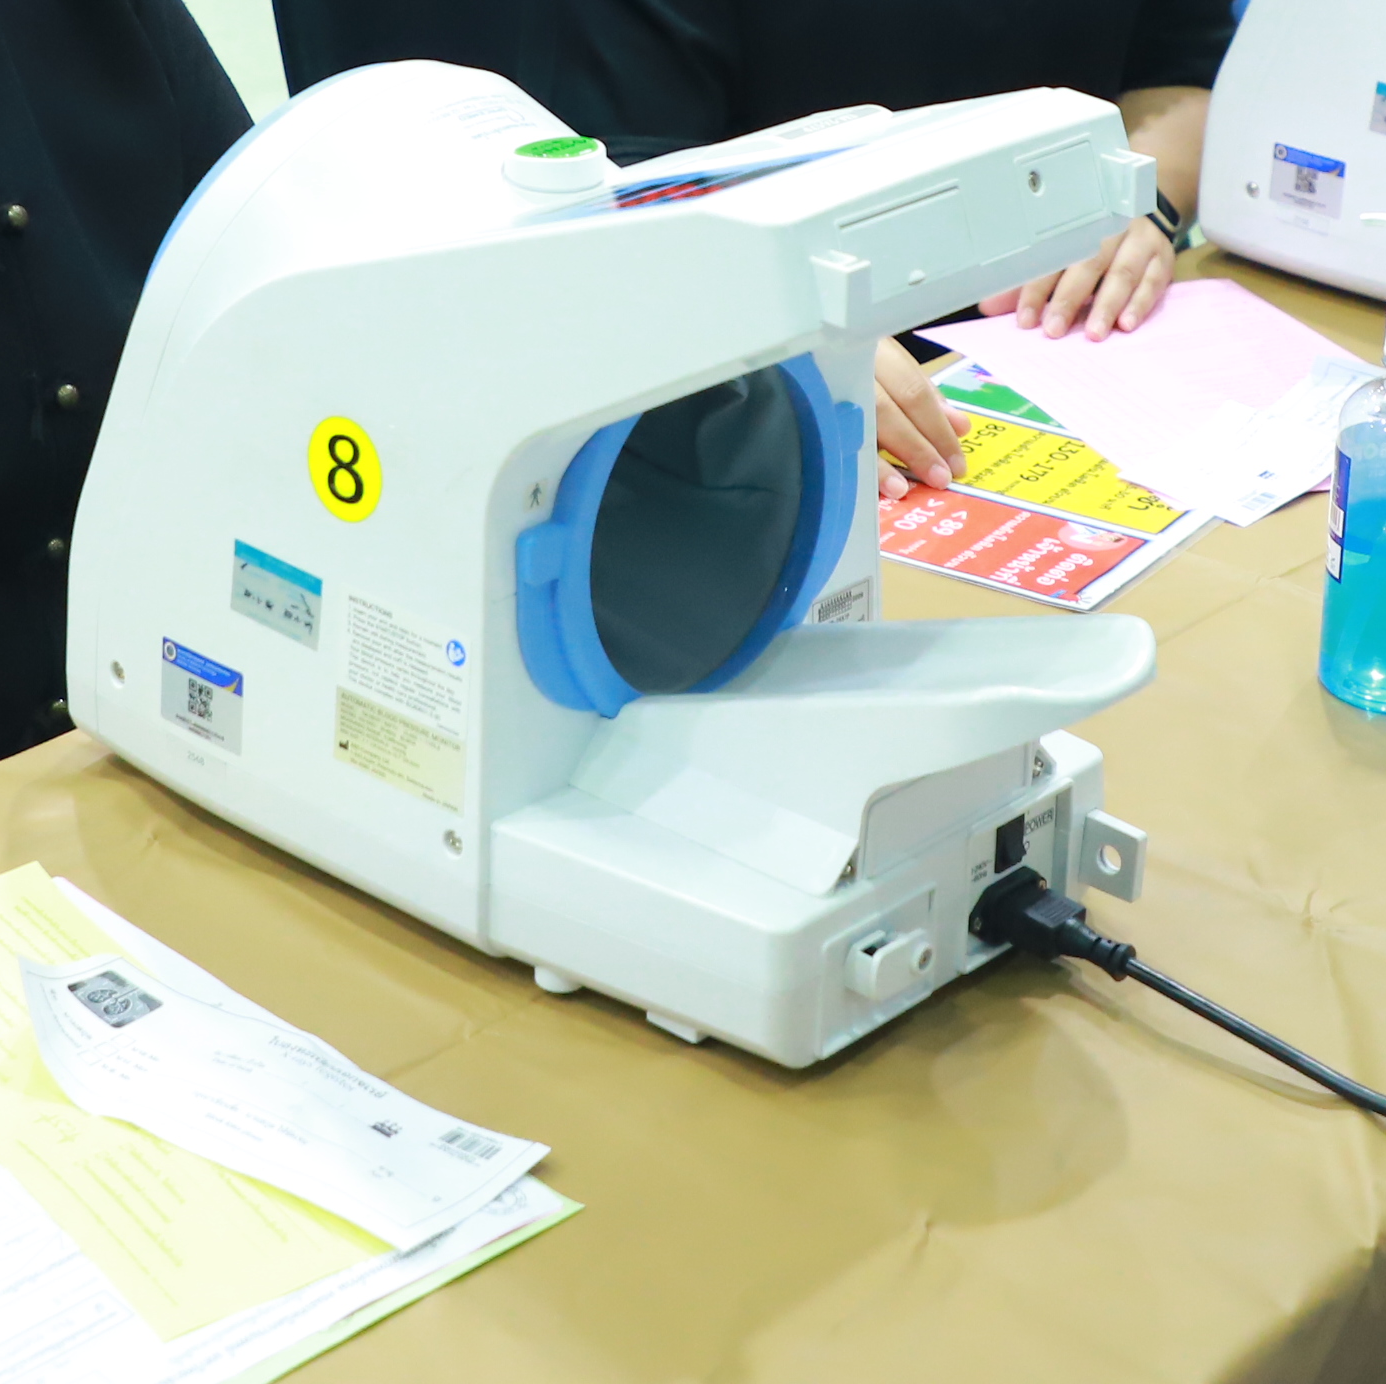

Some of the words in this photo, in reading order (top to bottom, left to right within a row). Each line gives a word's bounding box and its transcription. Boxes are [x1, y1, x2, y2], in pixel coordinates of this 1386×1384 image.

[958, 424, 1006, 453] 85-10
[327, 434, 364, 504] 8
[1021, 441, 1086, 481] 130-179
[990, 538, 1065, 586] เจ้าหน้าที่
[1036, 553, 1094, 586] ติดต่อ
[1024, 806, 1055, 836] POWER
